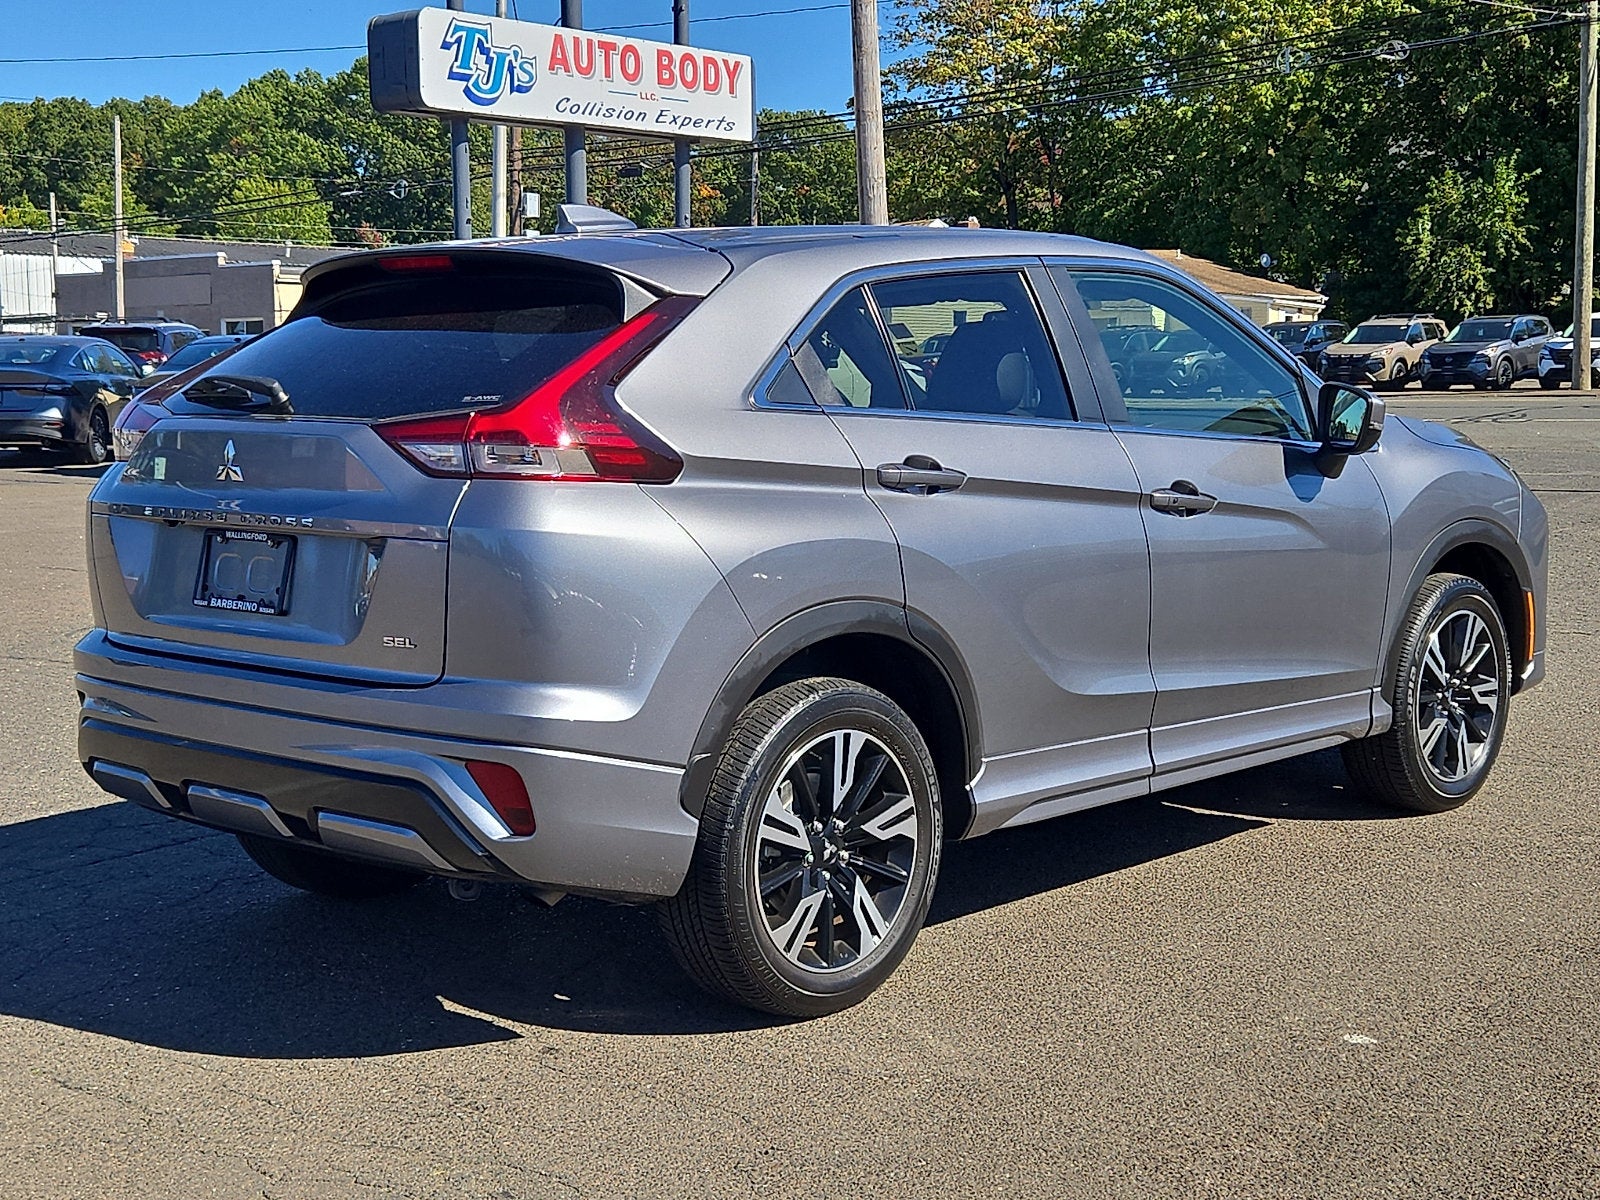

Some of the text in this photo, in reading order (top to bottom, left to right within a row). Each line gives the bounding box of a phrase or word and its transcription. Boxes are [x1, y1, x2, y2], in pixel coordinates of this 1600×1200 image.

[440, 17, 537, 106] TJ's
[548, 33, 742, 98] AUTO BODY
[639, 91, 659, 102] LLC.
[555, 97, 736, 132] Collision Experts
[225, 530, 268, 541] WALLINGFORD
[210, 597, 258, 612] BARBERINO
[383, 636, 416, 648] SEL
